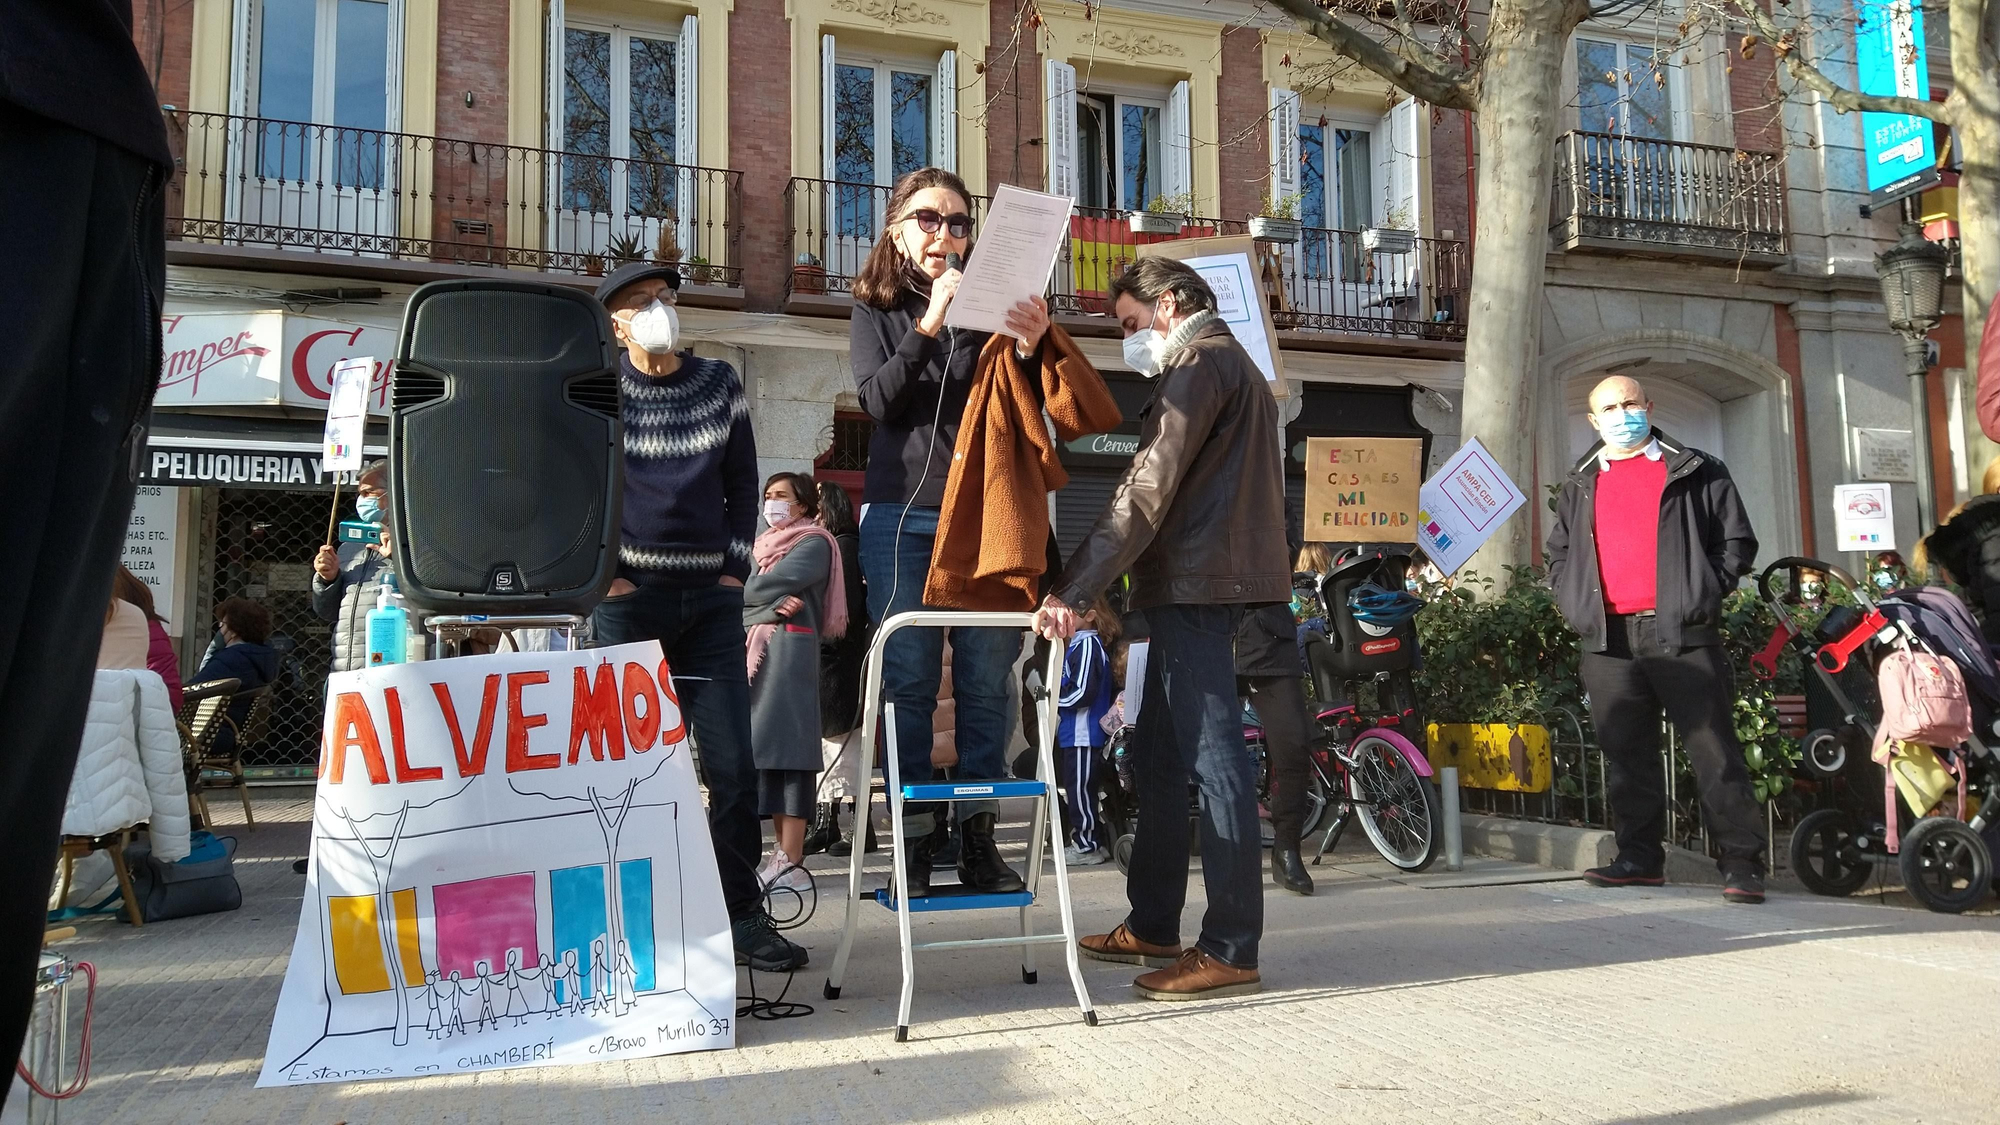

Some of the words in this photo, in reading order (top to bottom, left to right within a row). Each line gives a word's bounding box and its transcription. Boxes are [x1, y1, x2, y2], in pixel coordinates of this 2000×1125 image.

[151, 452, 306, 484] PELUQUERIA
[1329, 448, 1378, 464] ESTA
[1327, 472, 1372, 486] CASA
[1381, 472, 1400, 485] ES
[1461, 468, 1482, 493] AMPA
[1479, 488, 1497, 508] CEIP
[1338, 491, 1366, 507] MI
[1455, 475, 1475, 501] Asunción
[1473, 497, 1489, 515] Rincón
[1322, 511, 1410, 527] FELICIDAD
[131, 546, 152, 555] PARA
[318, 656, 685, 786] ALVEMOS
[287, 1062, 394, 1082] Estamos
[414, 1063, 440, 1073] en
[457, 1036, 556, 1069] CHAMBERÍ
[588, 1035, 647, 1055] c/Bravo
[657, 1018, 706, 1043] Murillo
[708, 1018, 730, 1037] 37
